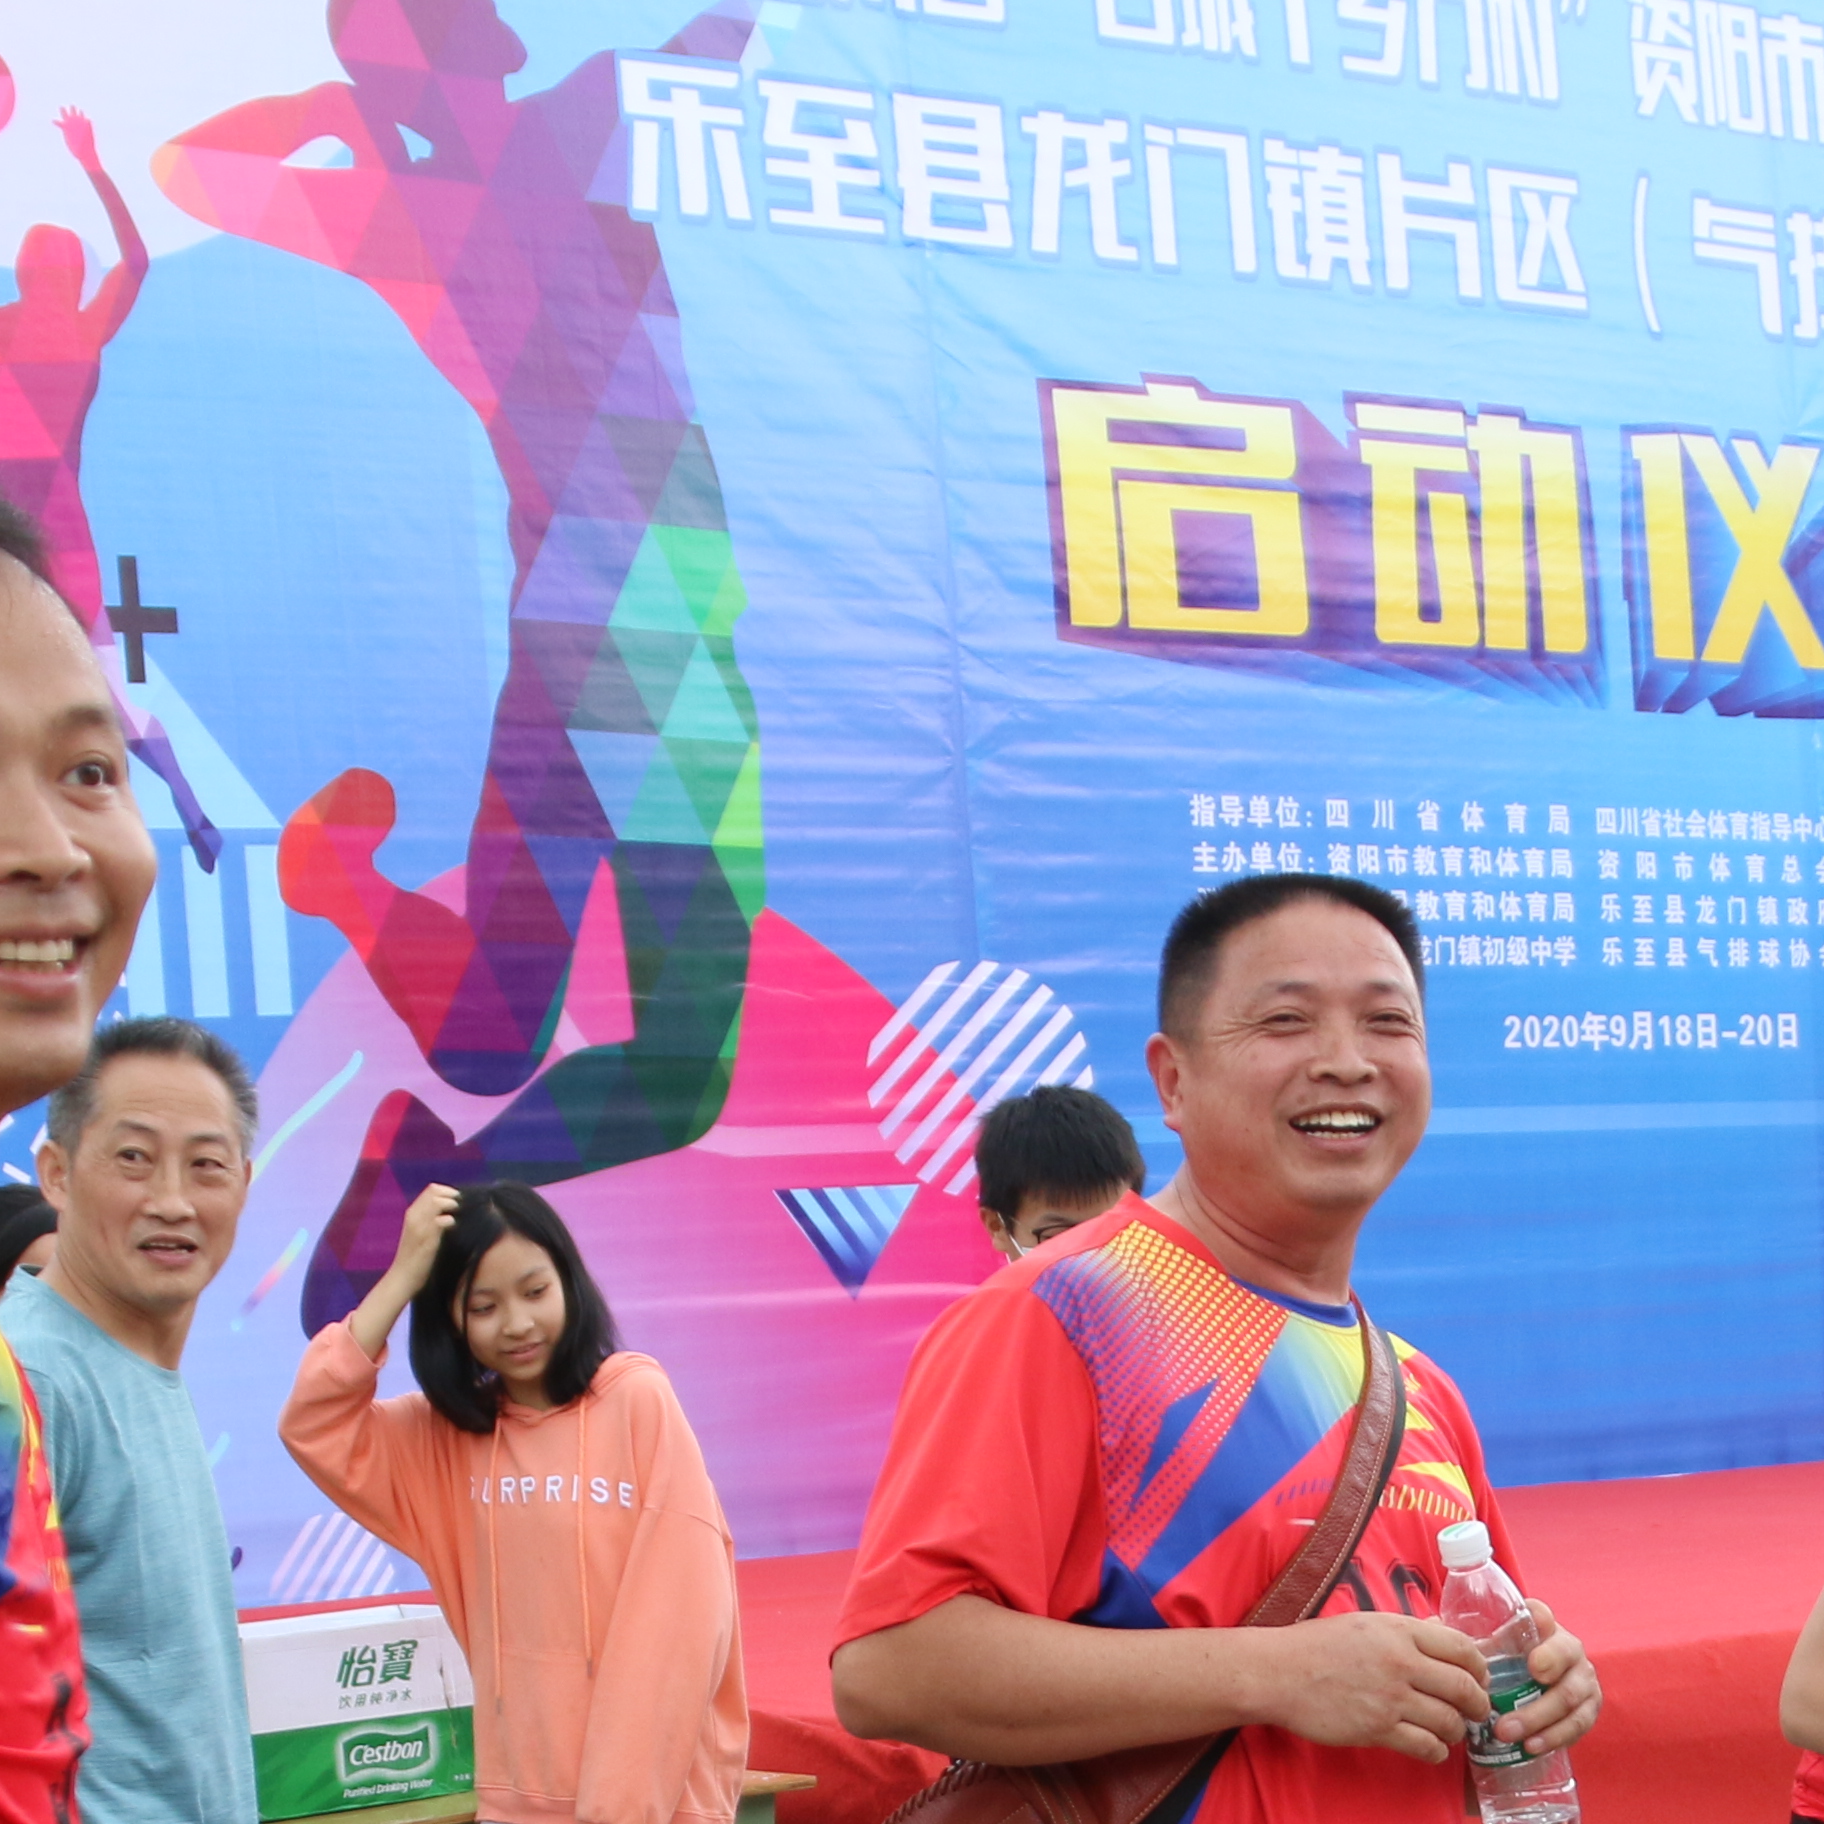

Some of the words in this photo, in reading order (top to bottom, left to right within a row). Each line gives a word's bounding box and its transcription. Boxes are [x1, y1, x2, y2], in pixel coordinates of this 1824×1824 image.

[1390, 889, 1575, 923] 教育和体育局
[469, 1474, 634, 1509] URPRISE
[336, 1639, 418, 1689] 怡寶
